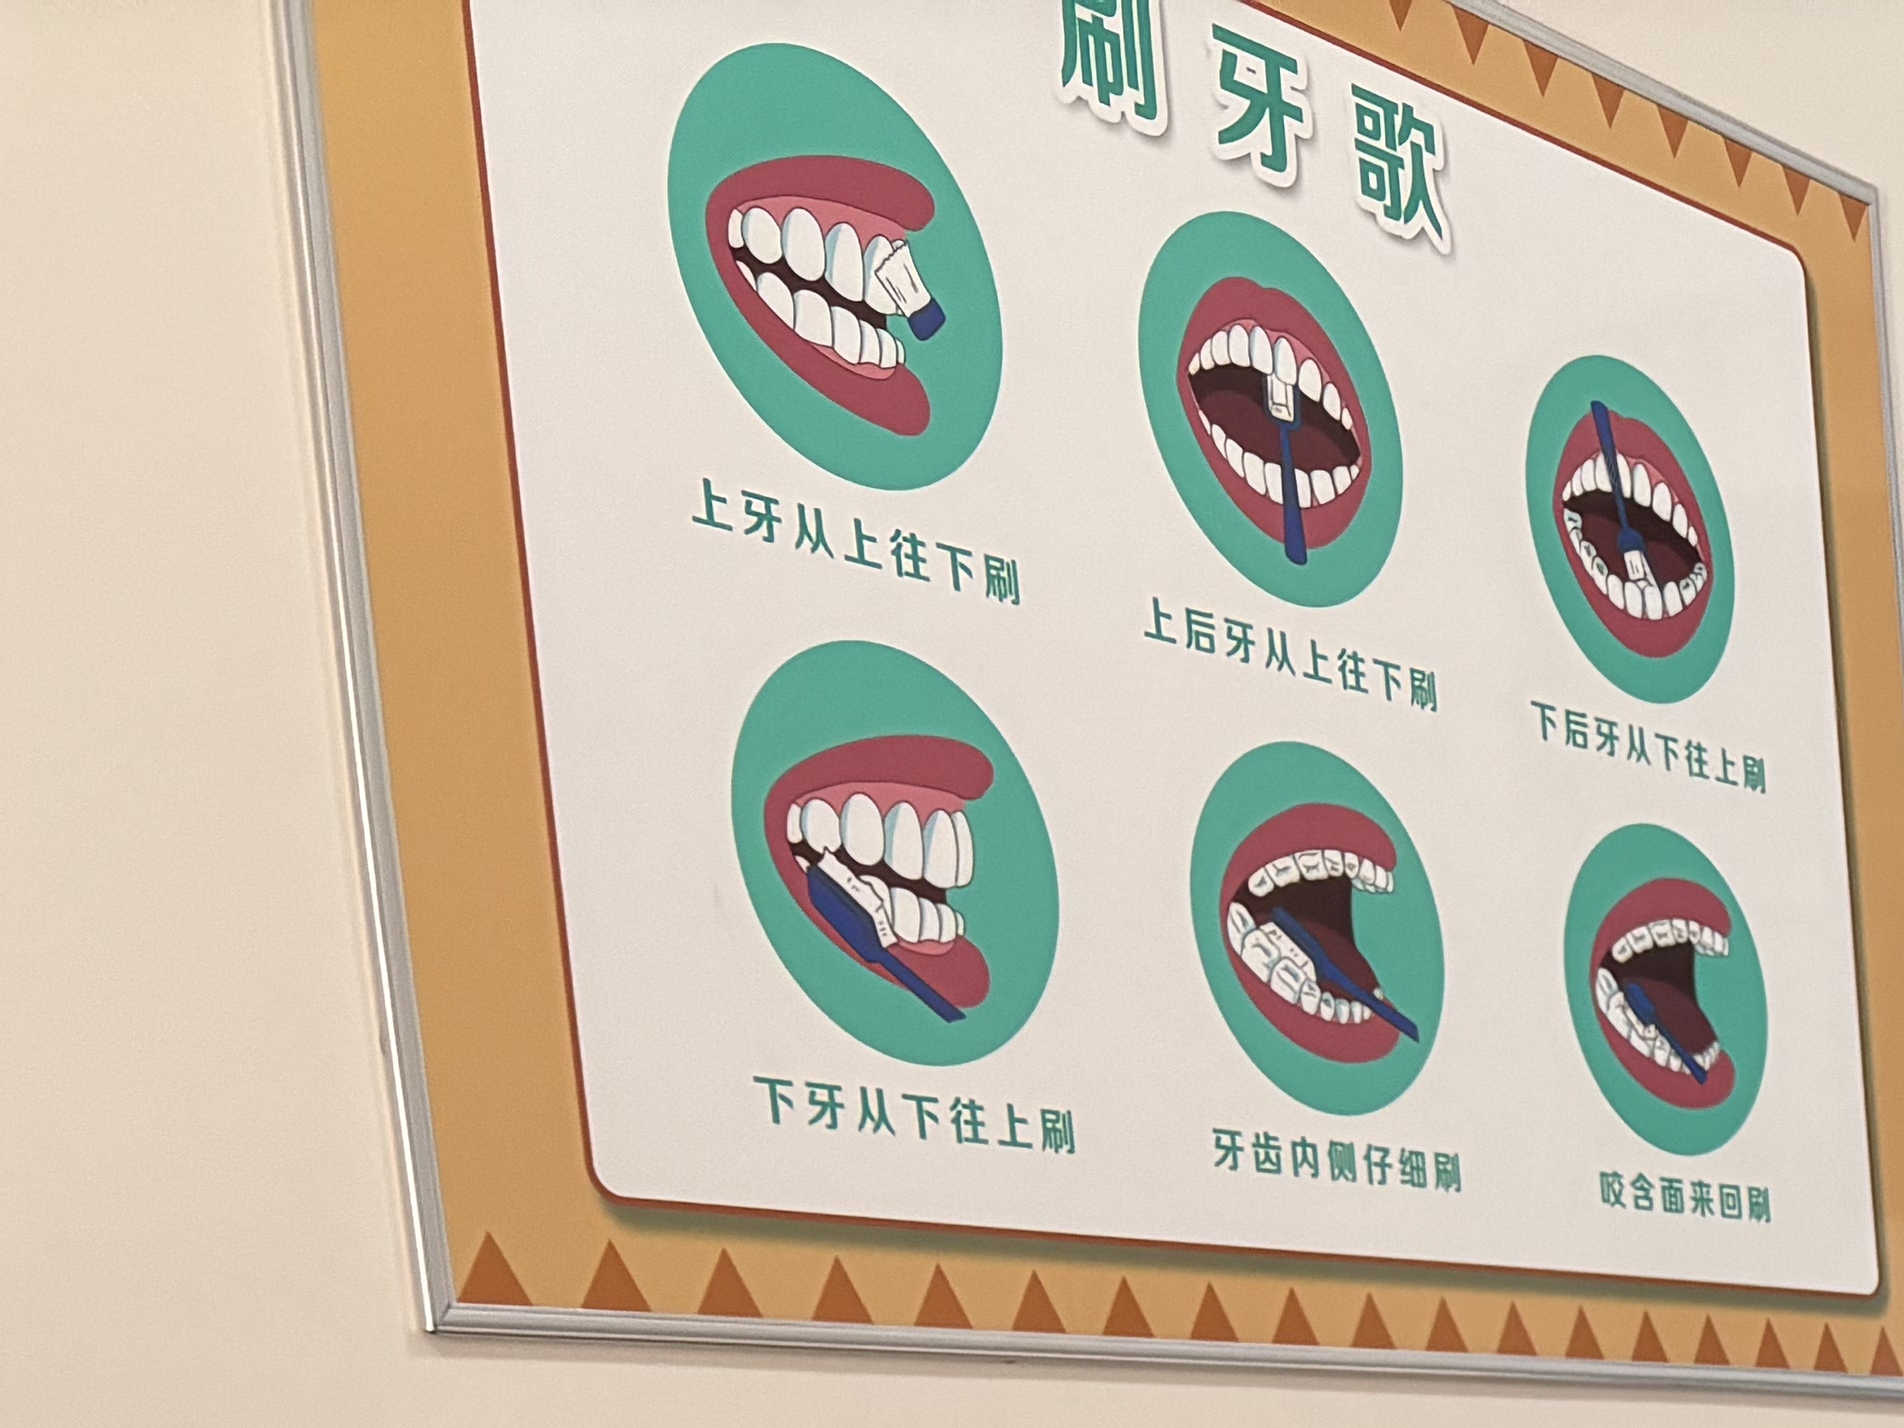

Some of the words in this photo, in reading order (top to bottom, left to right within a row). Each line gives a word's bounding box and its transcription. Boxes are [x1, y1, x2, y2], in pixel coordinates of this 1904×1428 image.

[1061, 0, 1444, 241] 刷牙歌
[691, 477, 1022, 606] 上牙从上往下刷
[1143, 596, 1438, 713] 上后牙从上往下刷
[1530, 700, 1766, 795] 下后牙从下往上刷
[752, 1075, 1076, 1155] 下牙从下往上刷
[1211, 1127, 1463, 1193] 牙齿内侧仔细刷
[1599, 1170, 1773, 1224] 咬含面来回刷
